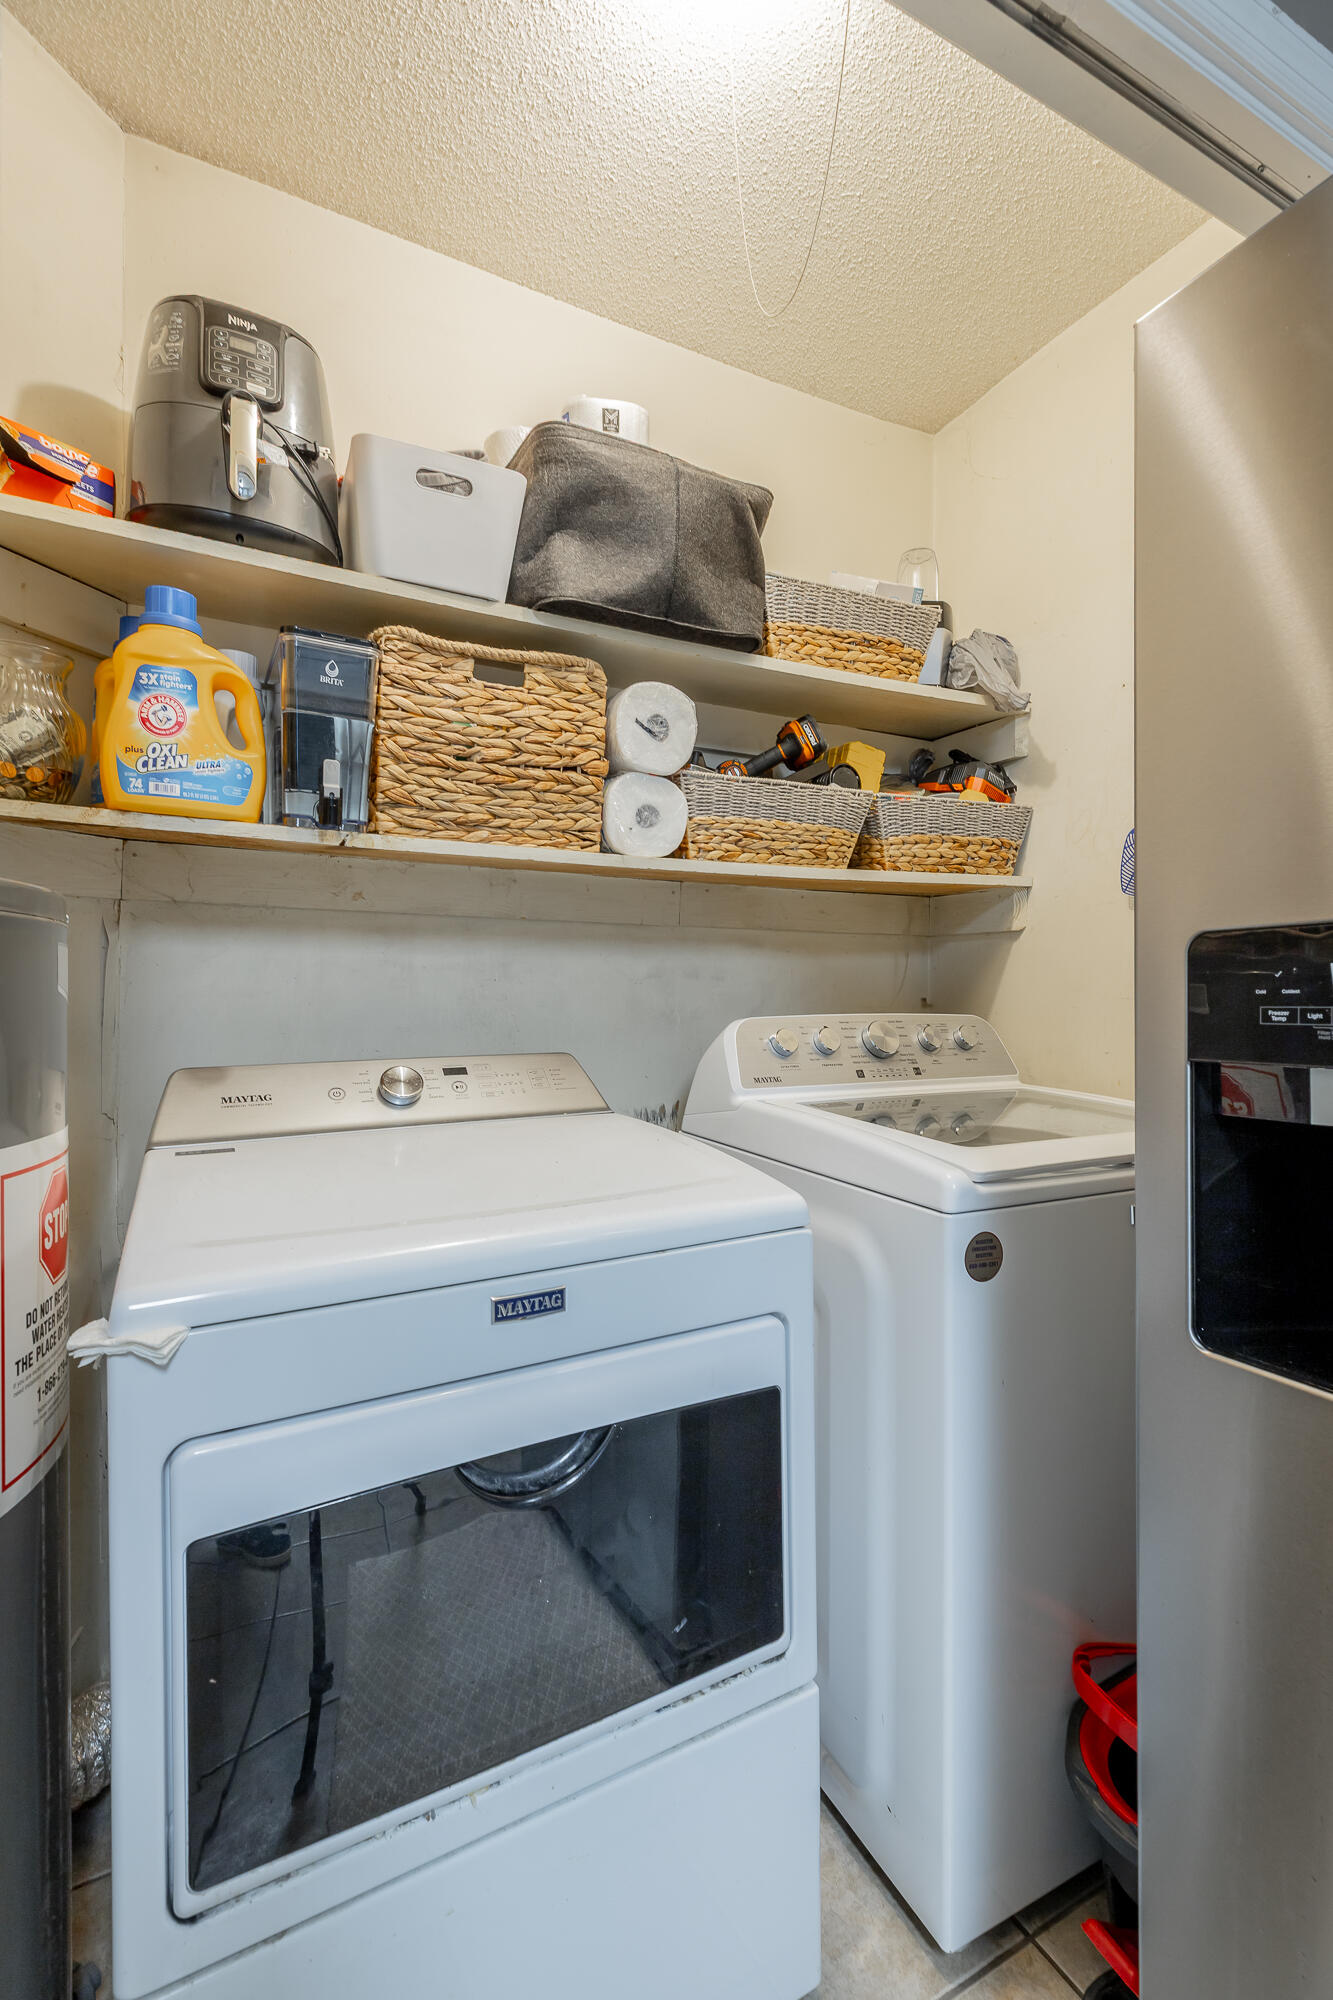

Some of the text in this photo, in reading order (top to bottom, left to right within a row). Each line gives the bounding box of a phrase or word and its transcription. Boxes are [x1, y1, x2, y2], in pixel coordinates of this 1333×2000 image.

[227, 313, 258, 332] NINJA
[138, 671, 159, 686] 3X
[159, 673, 181, 682] stain
[320, 675, 344, 687] BRITA
[125, 742, 178, 758] plus OXI
[136, 754, 189, 773] CLEAN
[196, 760, 222, 770] ULTRA
[129, 778, 143, 789] 74
[1307, 1012, 1323, 1020] Light
[753, 1076, 782, 1084] MAYTAG
[220, 1094, 273, 1105] MAYTAG
[44, 1199, 68, 1250] STOP
[26, 1307, 38, 1329] DO
[40, 1295, 53, 1320] NOT
[497, 1293, 562, 1318] MAYTAG
[32, 1313, 56, 1345] WATER
[15, 1351, 34, 1376] THE
[36, 1331, 57, 1362] PLACE
